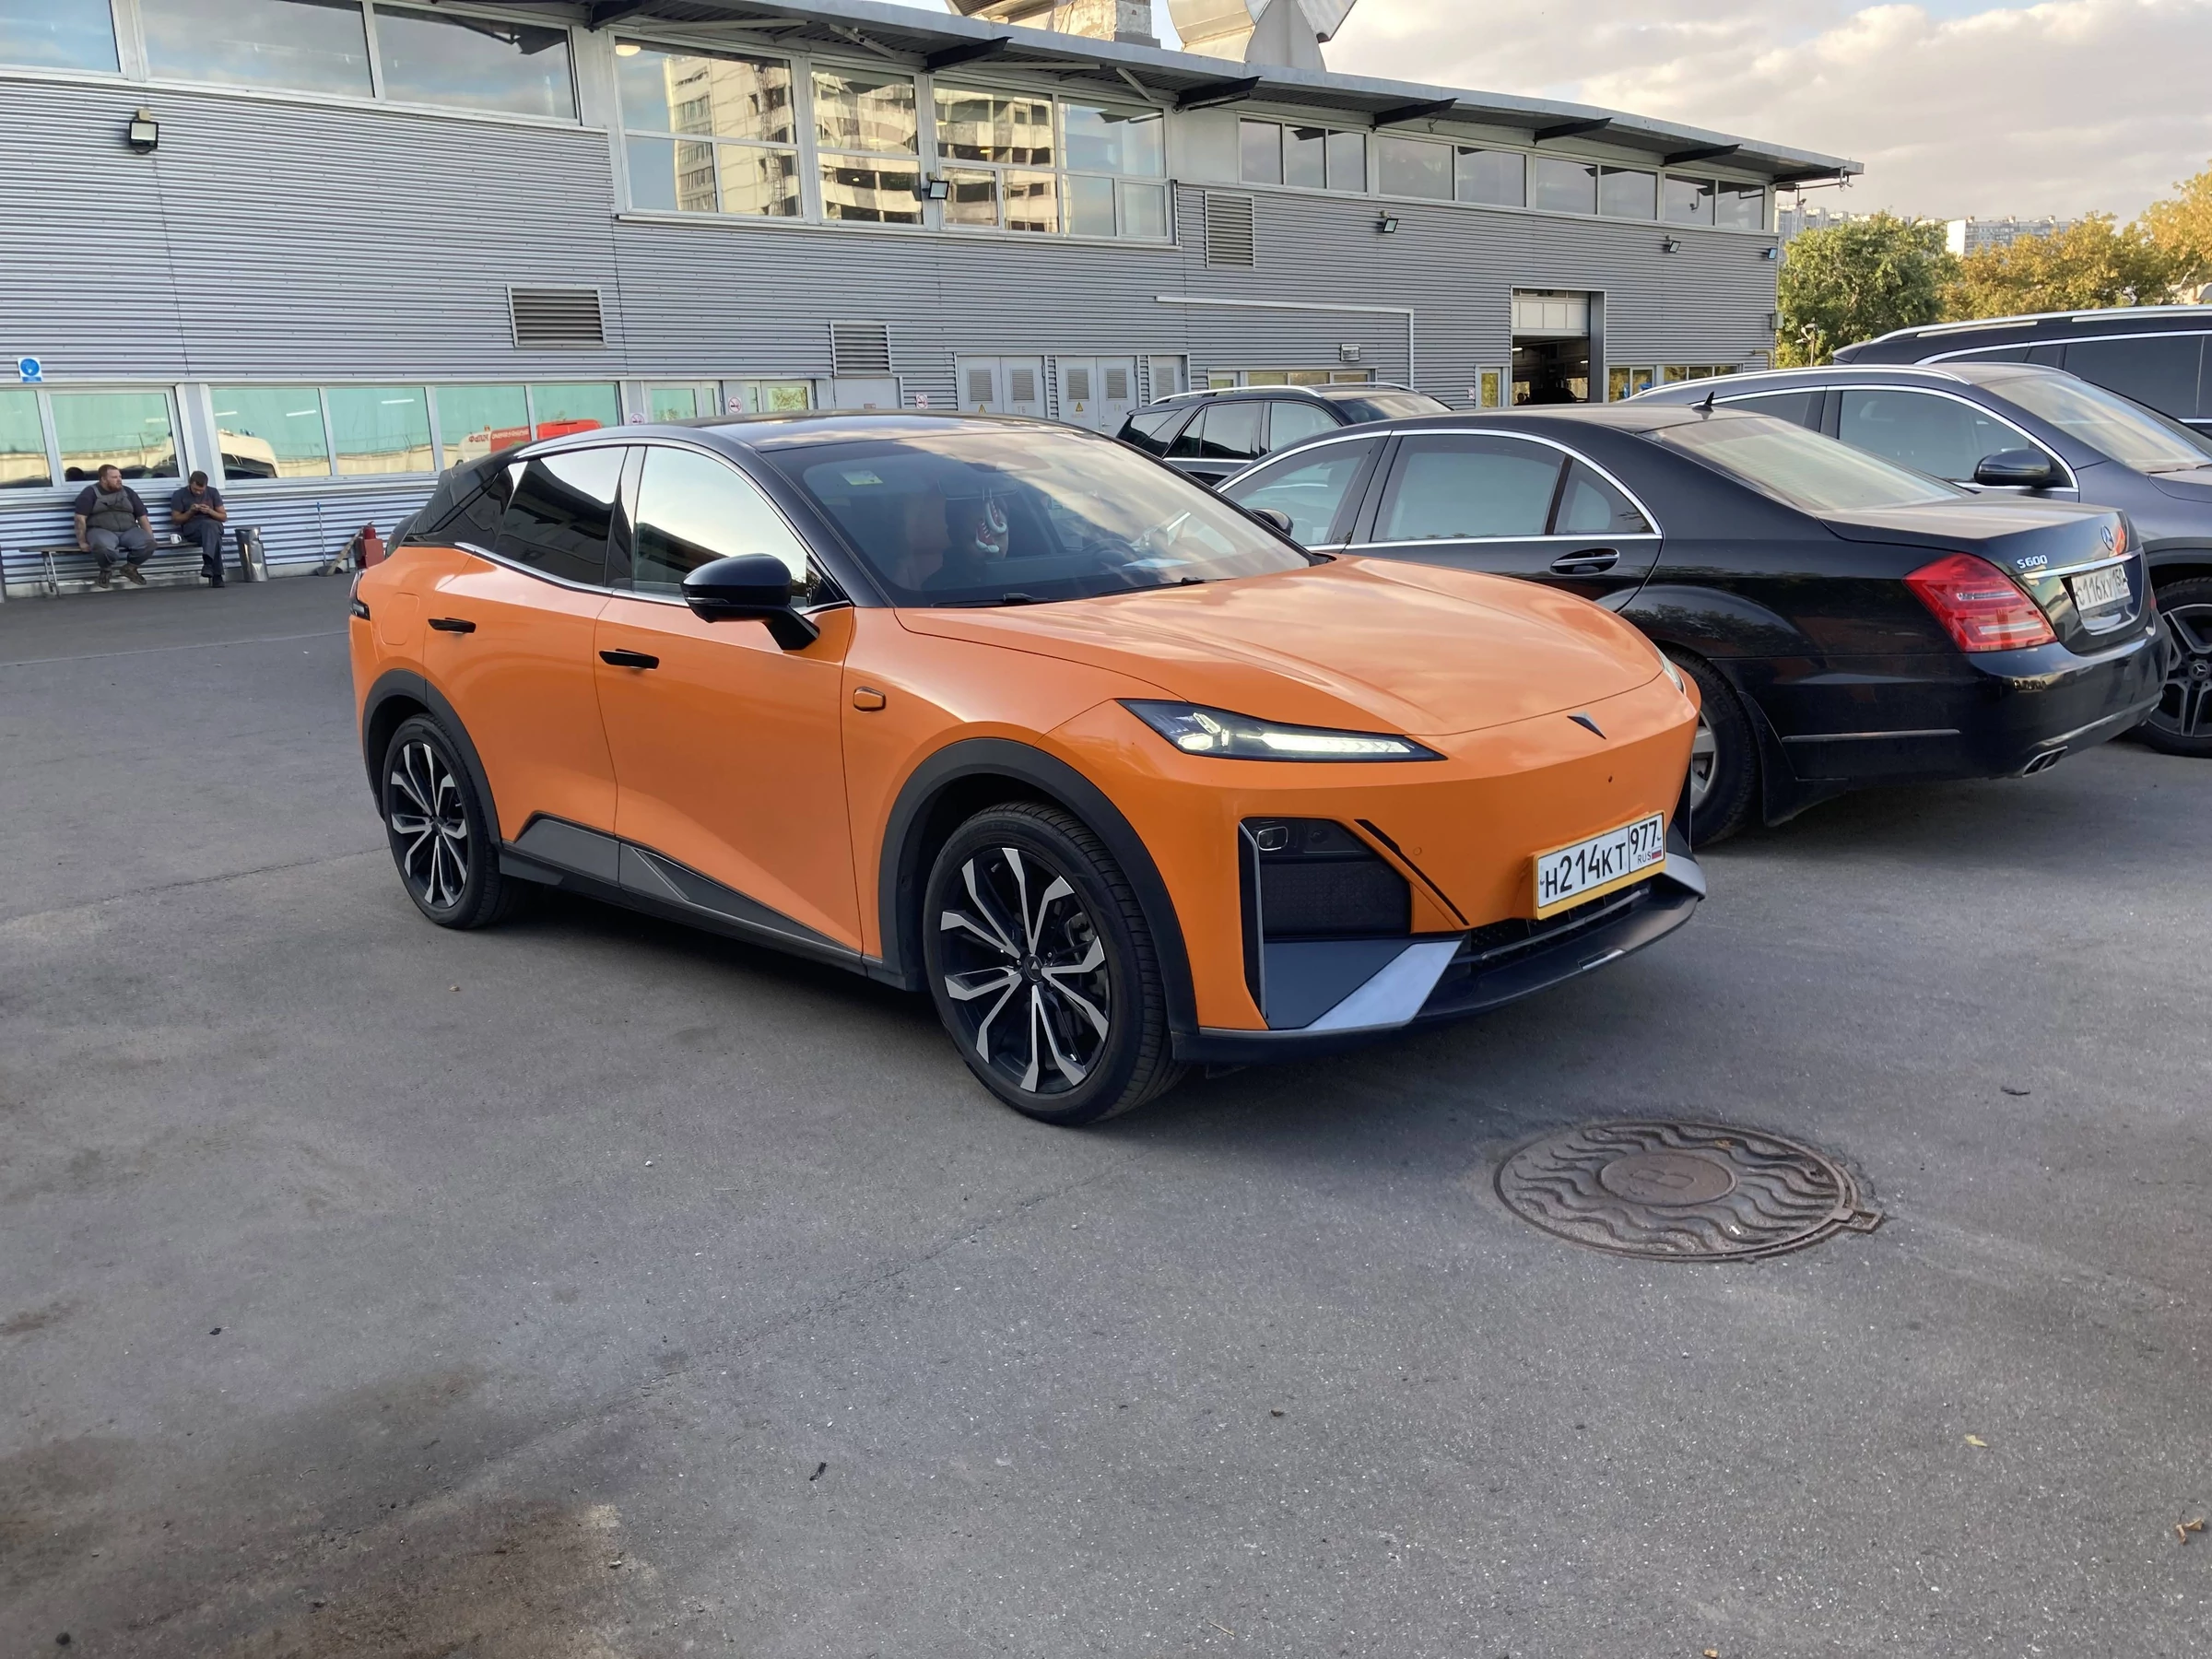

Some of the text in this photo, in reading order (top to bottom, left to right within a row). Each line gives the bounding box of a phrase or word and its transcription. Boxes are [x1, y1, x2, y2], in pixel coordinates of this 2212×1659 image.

[1546, 819, 1658, 899] H214KT 977
[1638, 853, 1652, 864] RUS
